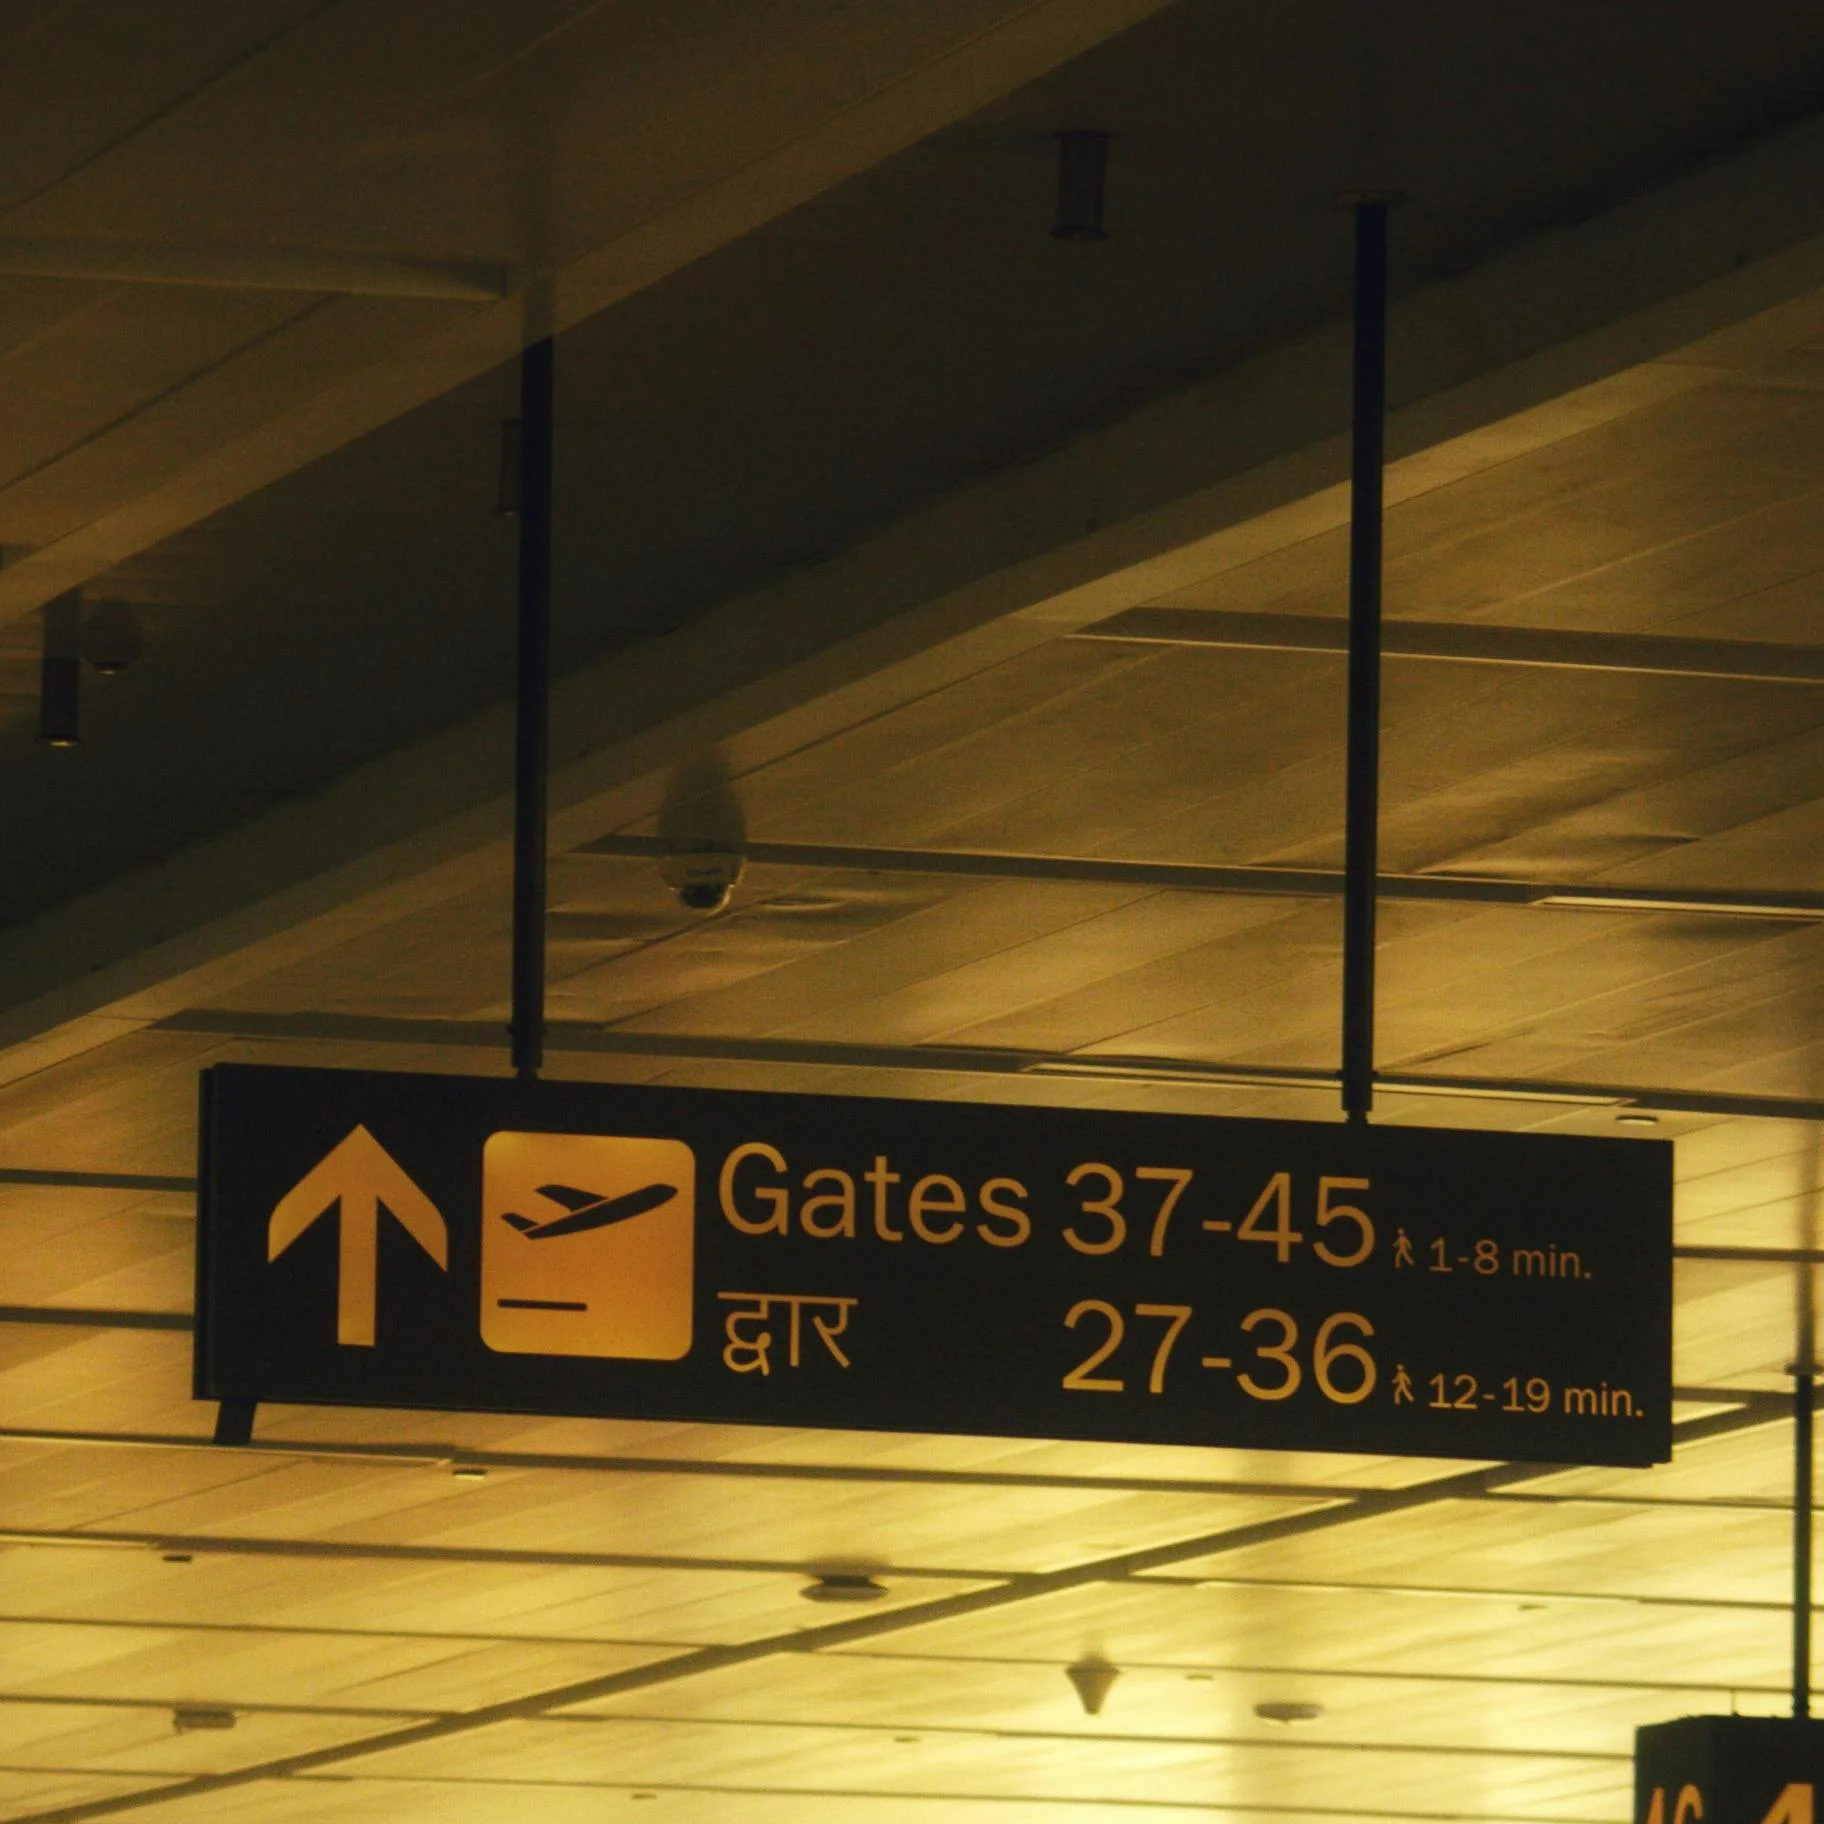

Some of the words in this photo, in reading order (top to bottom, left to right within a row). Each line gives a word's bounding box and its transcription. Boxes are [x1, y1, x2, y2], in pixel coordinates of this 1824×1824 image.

[718, 1140, 1031, 1248] Gates
[1061, 1161, 1377, 1268] 37-45
[1428, 1237, 1500, 1276] 1-8
[1512, 1244, 1592, 1279] min.
[716, 1290, 859, 1377] द्वार
[1061, 1299, 1377, 1405] 27-36
[1428, 1373, 1551, 1414] 12-19
[1563, 1381, 1646, 1418] min.
